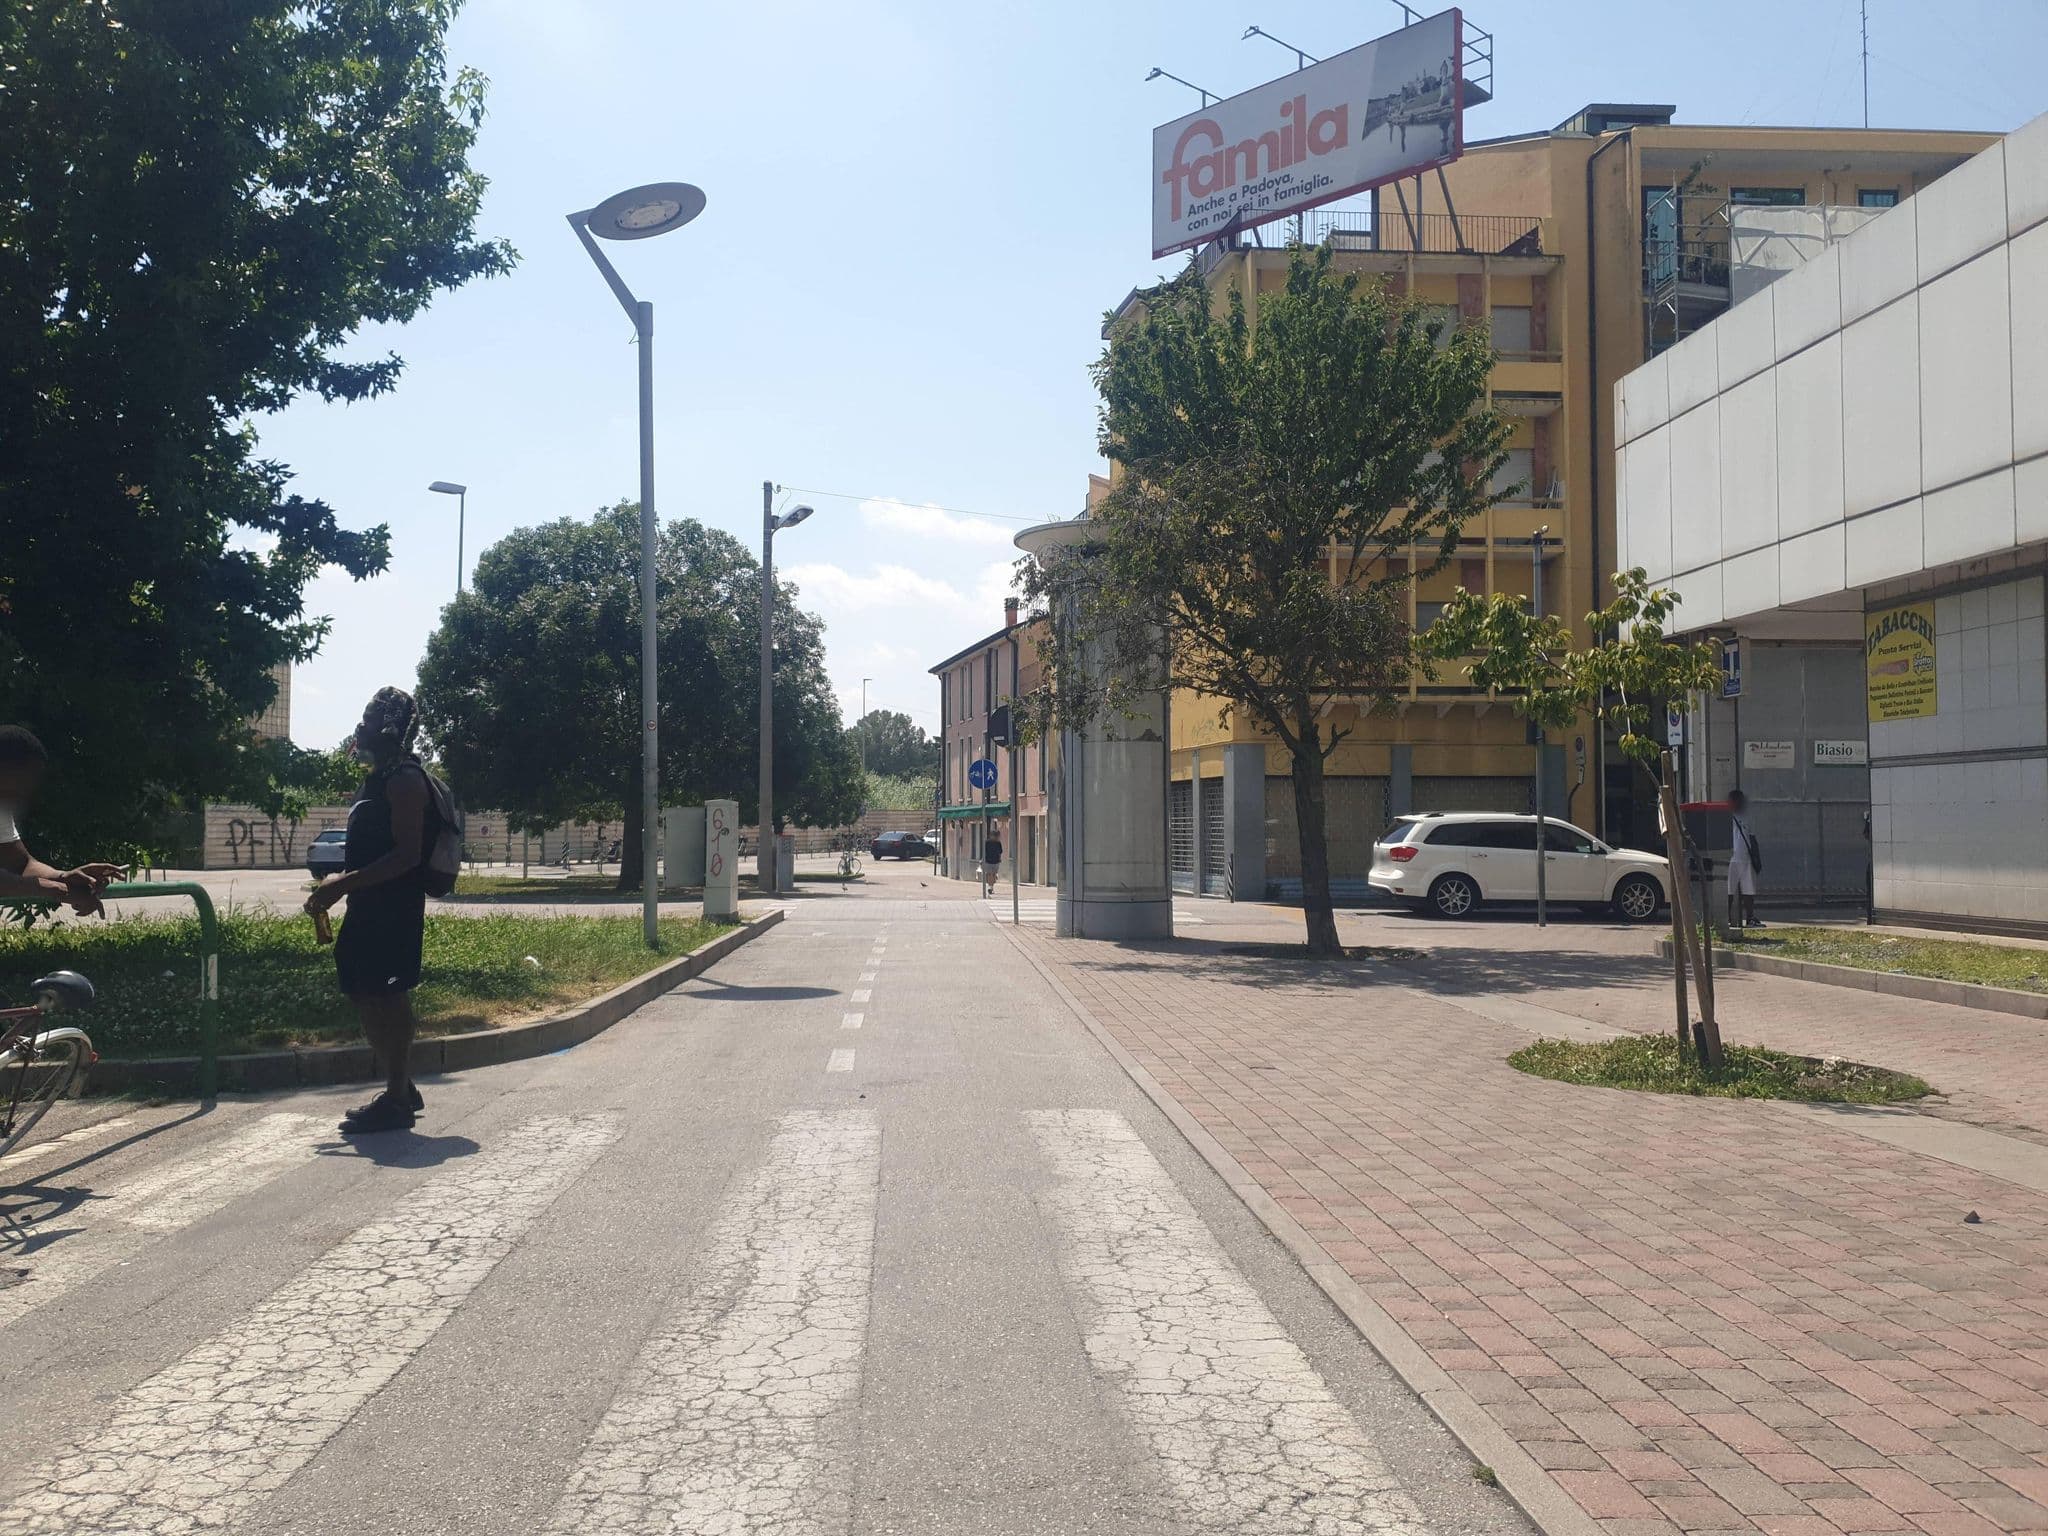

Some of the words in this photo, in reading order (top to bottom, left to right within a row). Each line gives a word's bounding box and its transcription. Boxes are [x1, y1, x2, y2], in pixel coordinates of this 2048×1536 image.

[1163, 94, 1349, 222] famila
[1187, 195, 1225, 218] Anche
[1229, 191, 1238, 203] a
[1241, 173, 1295, 199] Padova,
[1187, 216, 1209, 231] con
[1213, 205, 1232, 224] noi
[1237, 199, 1254, 213] sei
[1258, 194, 1270, 207] in
[1274, 174, 1334, 202] famiglia.
[1868, 609, 1933, 656] TABACCHI
[1878, 646, 1898, 656] Punto
[1898, 640, 1922, 653] Servizi
[1816, 743, 1854, 756] Biasio
